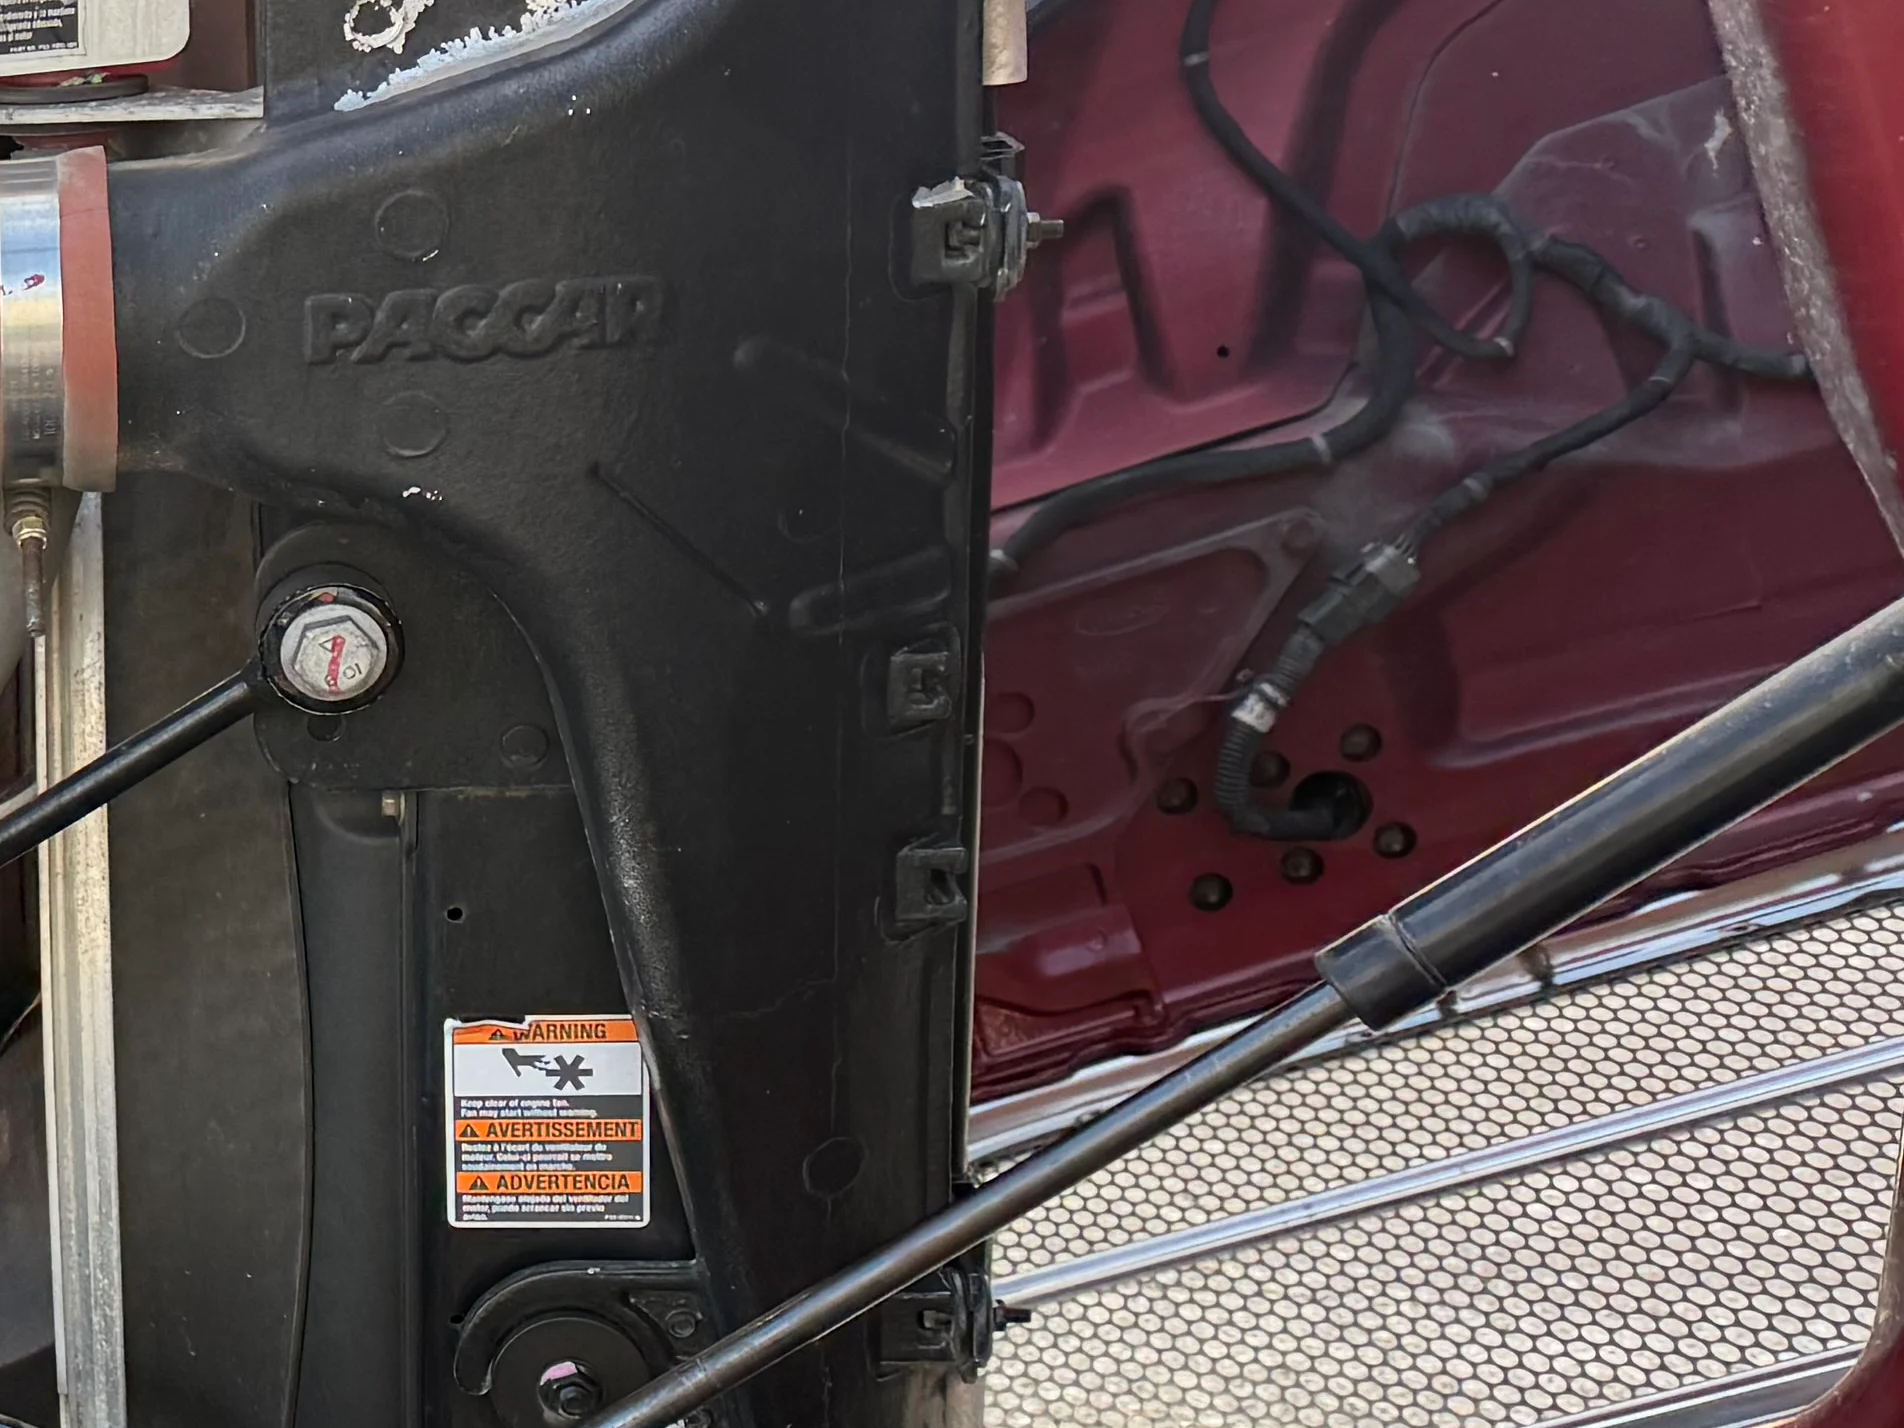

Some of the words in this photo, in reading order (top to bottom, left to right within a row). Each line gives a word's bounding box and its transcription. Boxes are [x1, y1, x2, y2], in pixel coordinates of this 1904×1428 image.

[304, 275, 664, 364] PACCAR
[513, 1023, 607, 1041] WARNING
[460, 1099, 483, 1109] Keep
[485, 1099, 507, 1107] clear
[509, 1099, 518, 1107] of
[521, 1100, 551, 1109] engine
[460, 1109, 477, 1117] Fan
[479, 1110, 498, 1118] may
[501, 1109, 521, 1117] start
[523, 1109, 559, 1117] without
[486, 1122, 641, 1138] AVERTISSEMENT
[532, 1143, 543, 1151] du
[595, 1143, 606, 1151] du
[496, 1174, 630, 1190] ADVERTENCIA
[552, 1195, 567, 1203] del
[614, 1195, 629, 1203] del
[521, 1204, 560, 1212] arrancar
[562, 1204, 575, 1212] sin
[577, 1205, 605, 1213] previo
